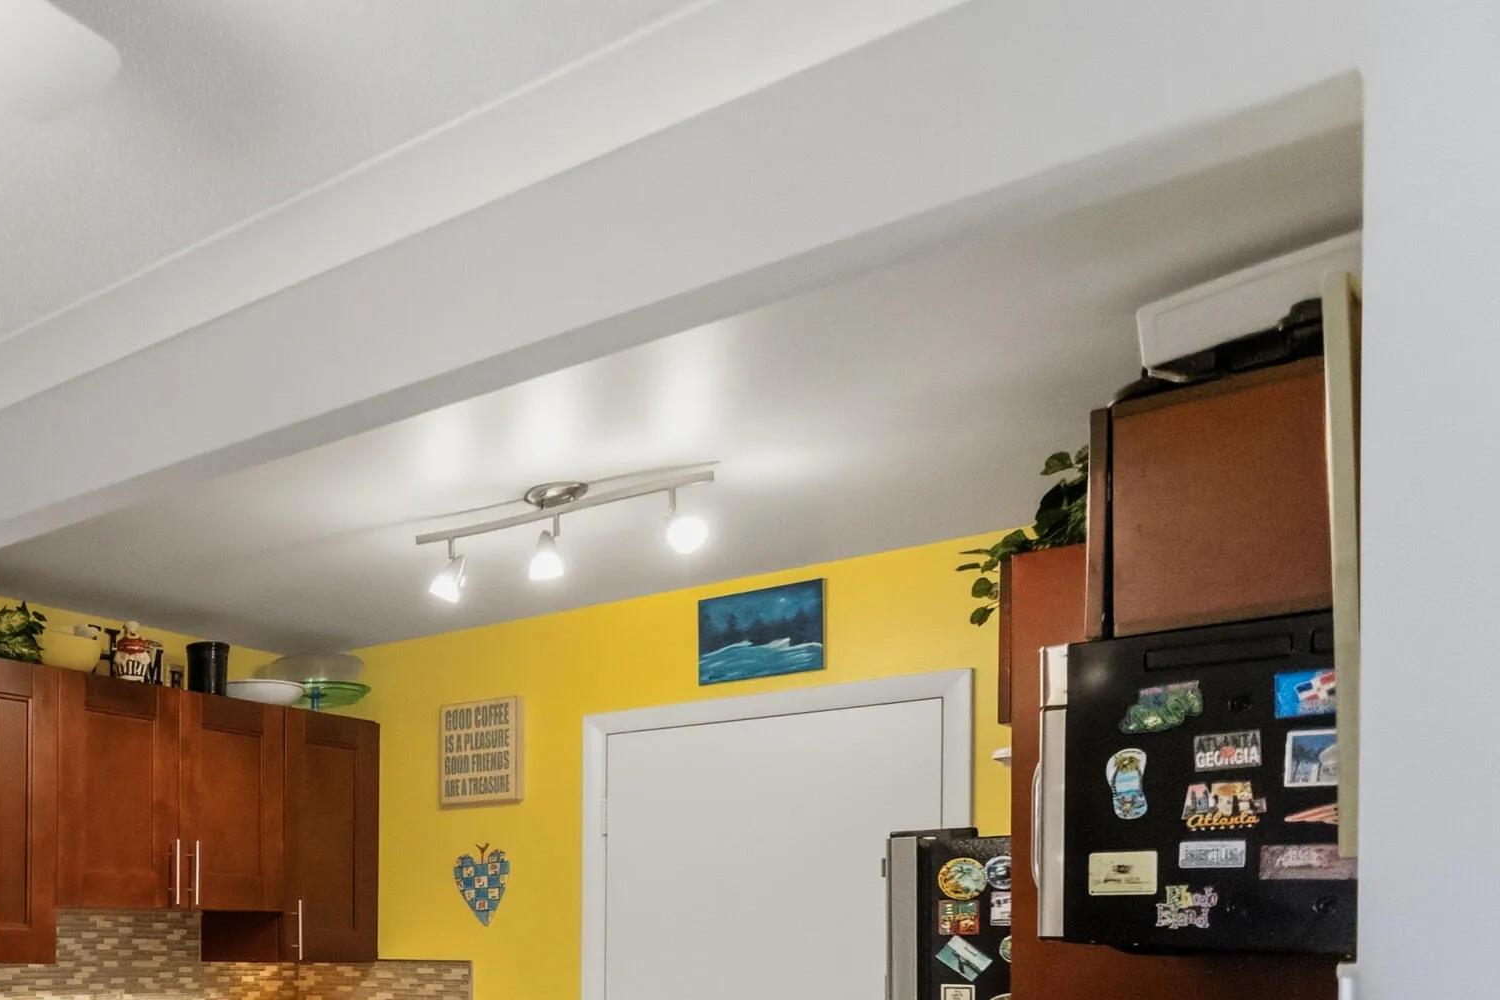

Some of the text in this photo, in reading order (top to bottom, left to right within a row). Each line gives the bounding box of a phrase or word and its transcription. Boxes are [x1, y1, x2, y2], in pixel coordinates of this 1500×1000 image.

[445, 702, 510, 731] GOOD COFFEE
[445, 728, 510, 754] IS A PLEASURE
[1197, 731, 1260, 752] ATLANTA
[444, 750, 510, 776] GOOD FRIENDS
[1195, 745, 1259, 768] GEORGIA
[444, 774, 510, 797] ARE A TREASURE
